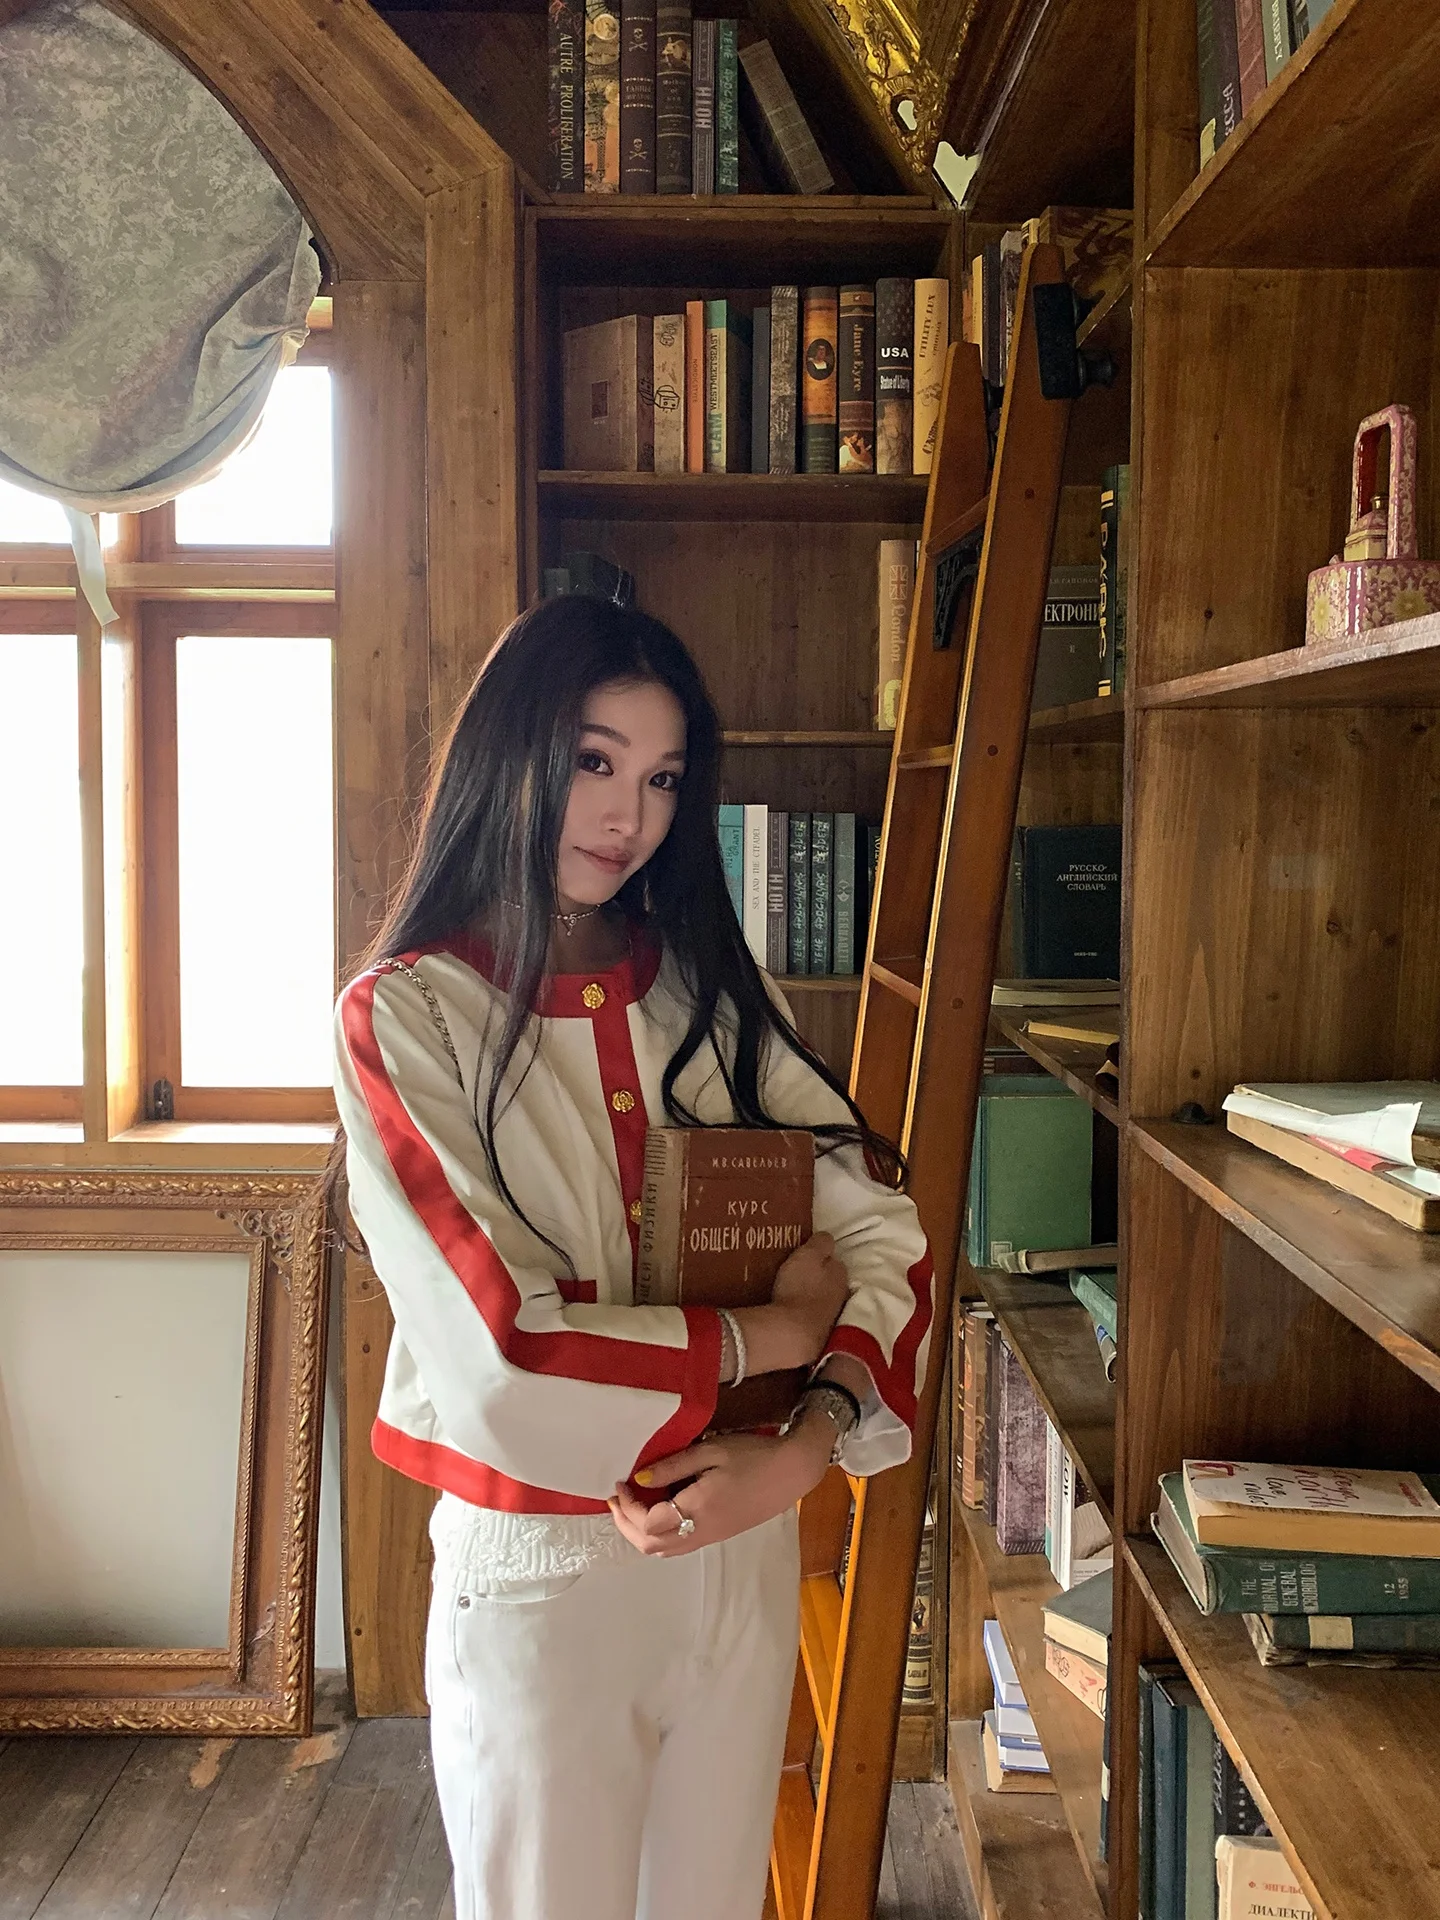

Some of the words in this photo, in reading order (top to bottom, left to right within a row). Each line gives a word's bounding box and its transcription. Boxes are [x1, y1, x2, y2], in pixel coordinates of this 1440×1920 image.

[560, 32, 573, 74] AUTRE
[560, 84, 574, 180] PROLIFERATION
[853, 323, 864, 356] Jane
[881, 347, 909, 358] USA
[853, 360, 865, 393] Eyre
[891, 604, 907, 663] London
[1056, 872, 1118, 882] АНГЛИЙСКИЙ
[1069, 864, 1107, 872] РУССКО-
[769, 874, 783, 912] HOTH
[1067, 883, 1107, 891] СЛОВАРЬ
[727, 1200, 768, 1218] КУРС
[690, 1222, 740, 1253] ОБЩЕЙ
[745, 1224, 802, 1250] ФИЗИКИ
[1241, 1578, 1257, 1596] THE
[1260, 1575, 1279, 1612] OURNAL
[1280, 1568, 1299, 1607] GENERAL
[1299, 1561, 1319, 1613] CROBIOLOG
[1384, 1583, 1395, 1594] 12
